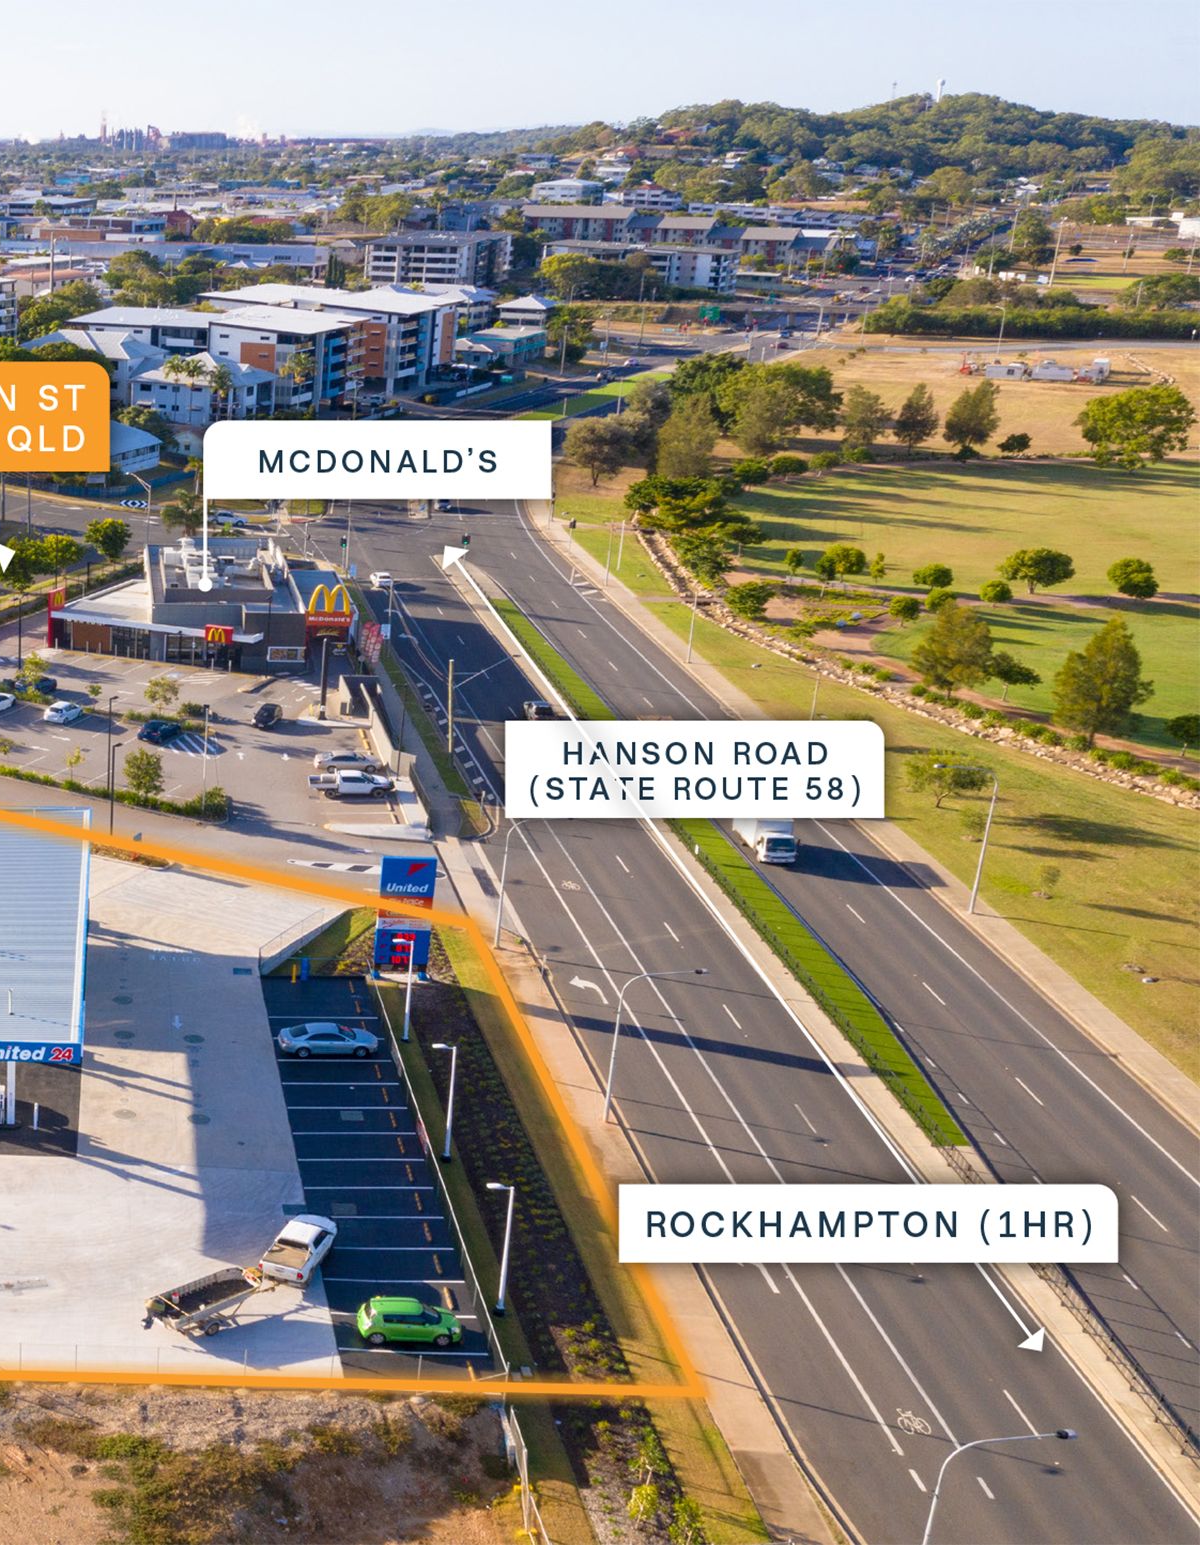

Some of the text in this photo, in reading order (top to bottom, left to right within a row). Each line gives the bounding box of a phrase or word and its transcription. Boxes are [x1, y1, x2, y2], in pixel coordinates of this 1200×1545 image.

[308, 615, 351, 624] McDonald's
[386, 882, 429, 894] United
[49, 1047, 74, 1062] 24
